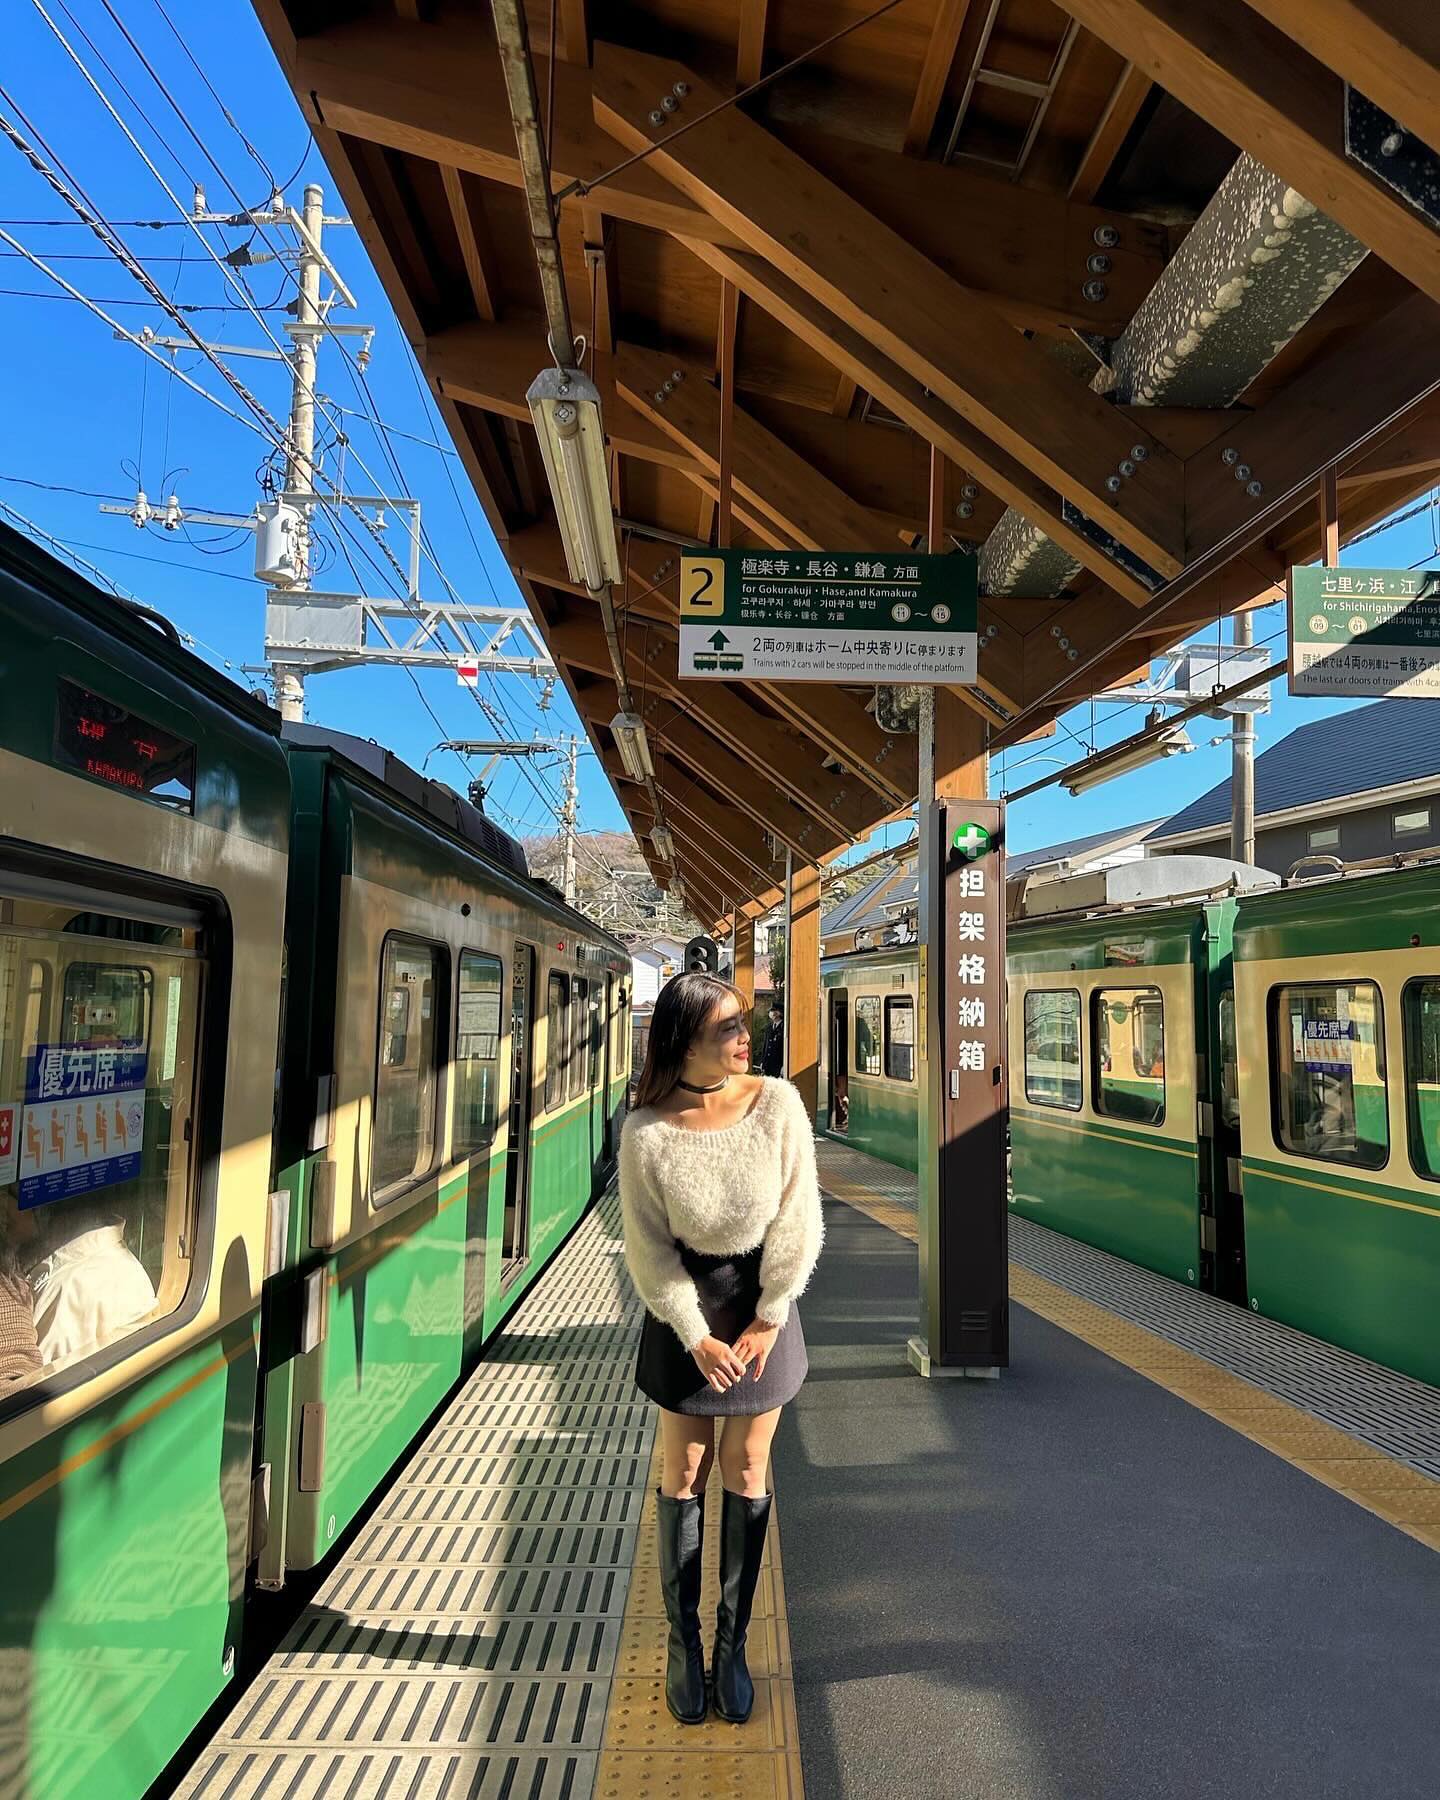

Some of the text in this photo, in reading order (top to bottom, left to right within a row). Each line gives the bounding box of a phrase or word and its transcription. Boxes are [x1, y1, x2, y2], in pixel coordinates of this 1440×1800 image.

[689, 567, 713, 606] 2
[742, 584, 756, 593] for
[759, 584, 811, 597] Gokurakuji
[869, 587, 917, 598] Kamakura
[1323, 601, 1337, 611] for
[753, 658, 773, 668] Trains
[775, 659, 790, 668] with
[792, 660, 797, 668] 2
[813, 660, 825, 669] will
[826, 660, 836, 669] be
[836, 661, 865, 671] stopped
[867, 662, 873, 670] in
[875, 662, 886, 671] the
[888, 662, 911, 671] middle
[913, 662, 920, 671] of
[922, 663, 933, 672] the
[1303, 674, 1318, 684] The
[1320, 675, 1333, 684] last
[1349, 676, 1371, 686] doors
[1373, 677, 1381, 686] of
[957, 868, 986, 1071] 担架格納箱
[1307, 1021, 1340, 1039] 優先席
[38, 1045, 118, 1098] 優先席
